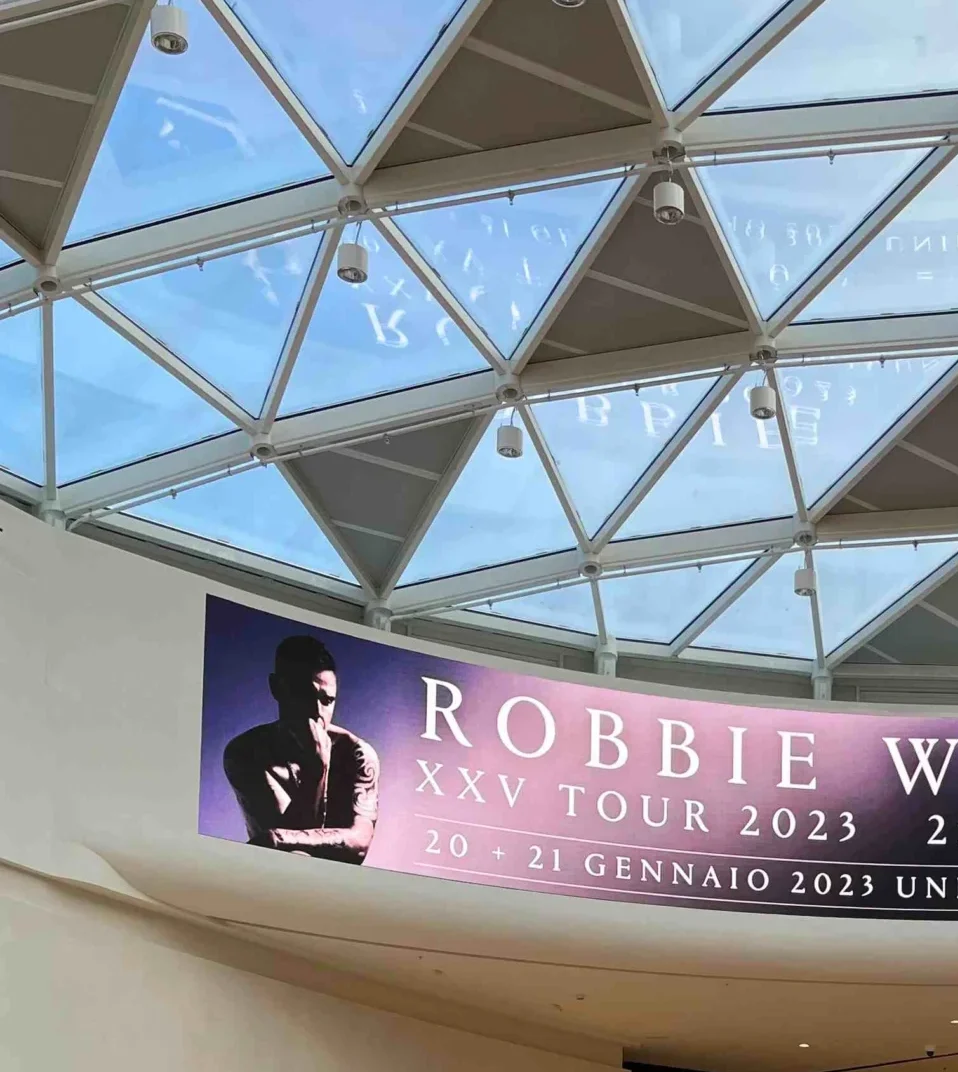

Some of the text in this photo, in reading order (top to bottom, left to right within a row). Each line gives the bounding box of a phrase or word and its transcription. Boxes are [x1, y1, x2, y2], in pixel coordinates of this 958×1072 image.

[419, 676, 817, 790] ROBBIE
[415, 759, 526, 808] XXV
[559, 784, 710, 833] TOUR
[740, 805, 857, 841] 2023
[425, 830, 468, 858] 20
[528, 845, 561, 872] 21
[584, 853, 770, 892] GENNAIO
[791, 871, 874, 897] 2023
